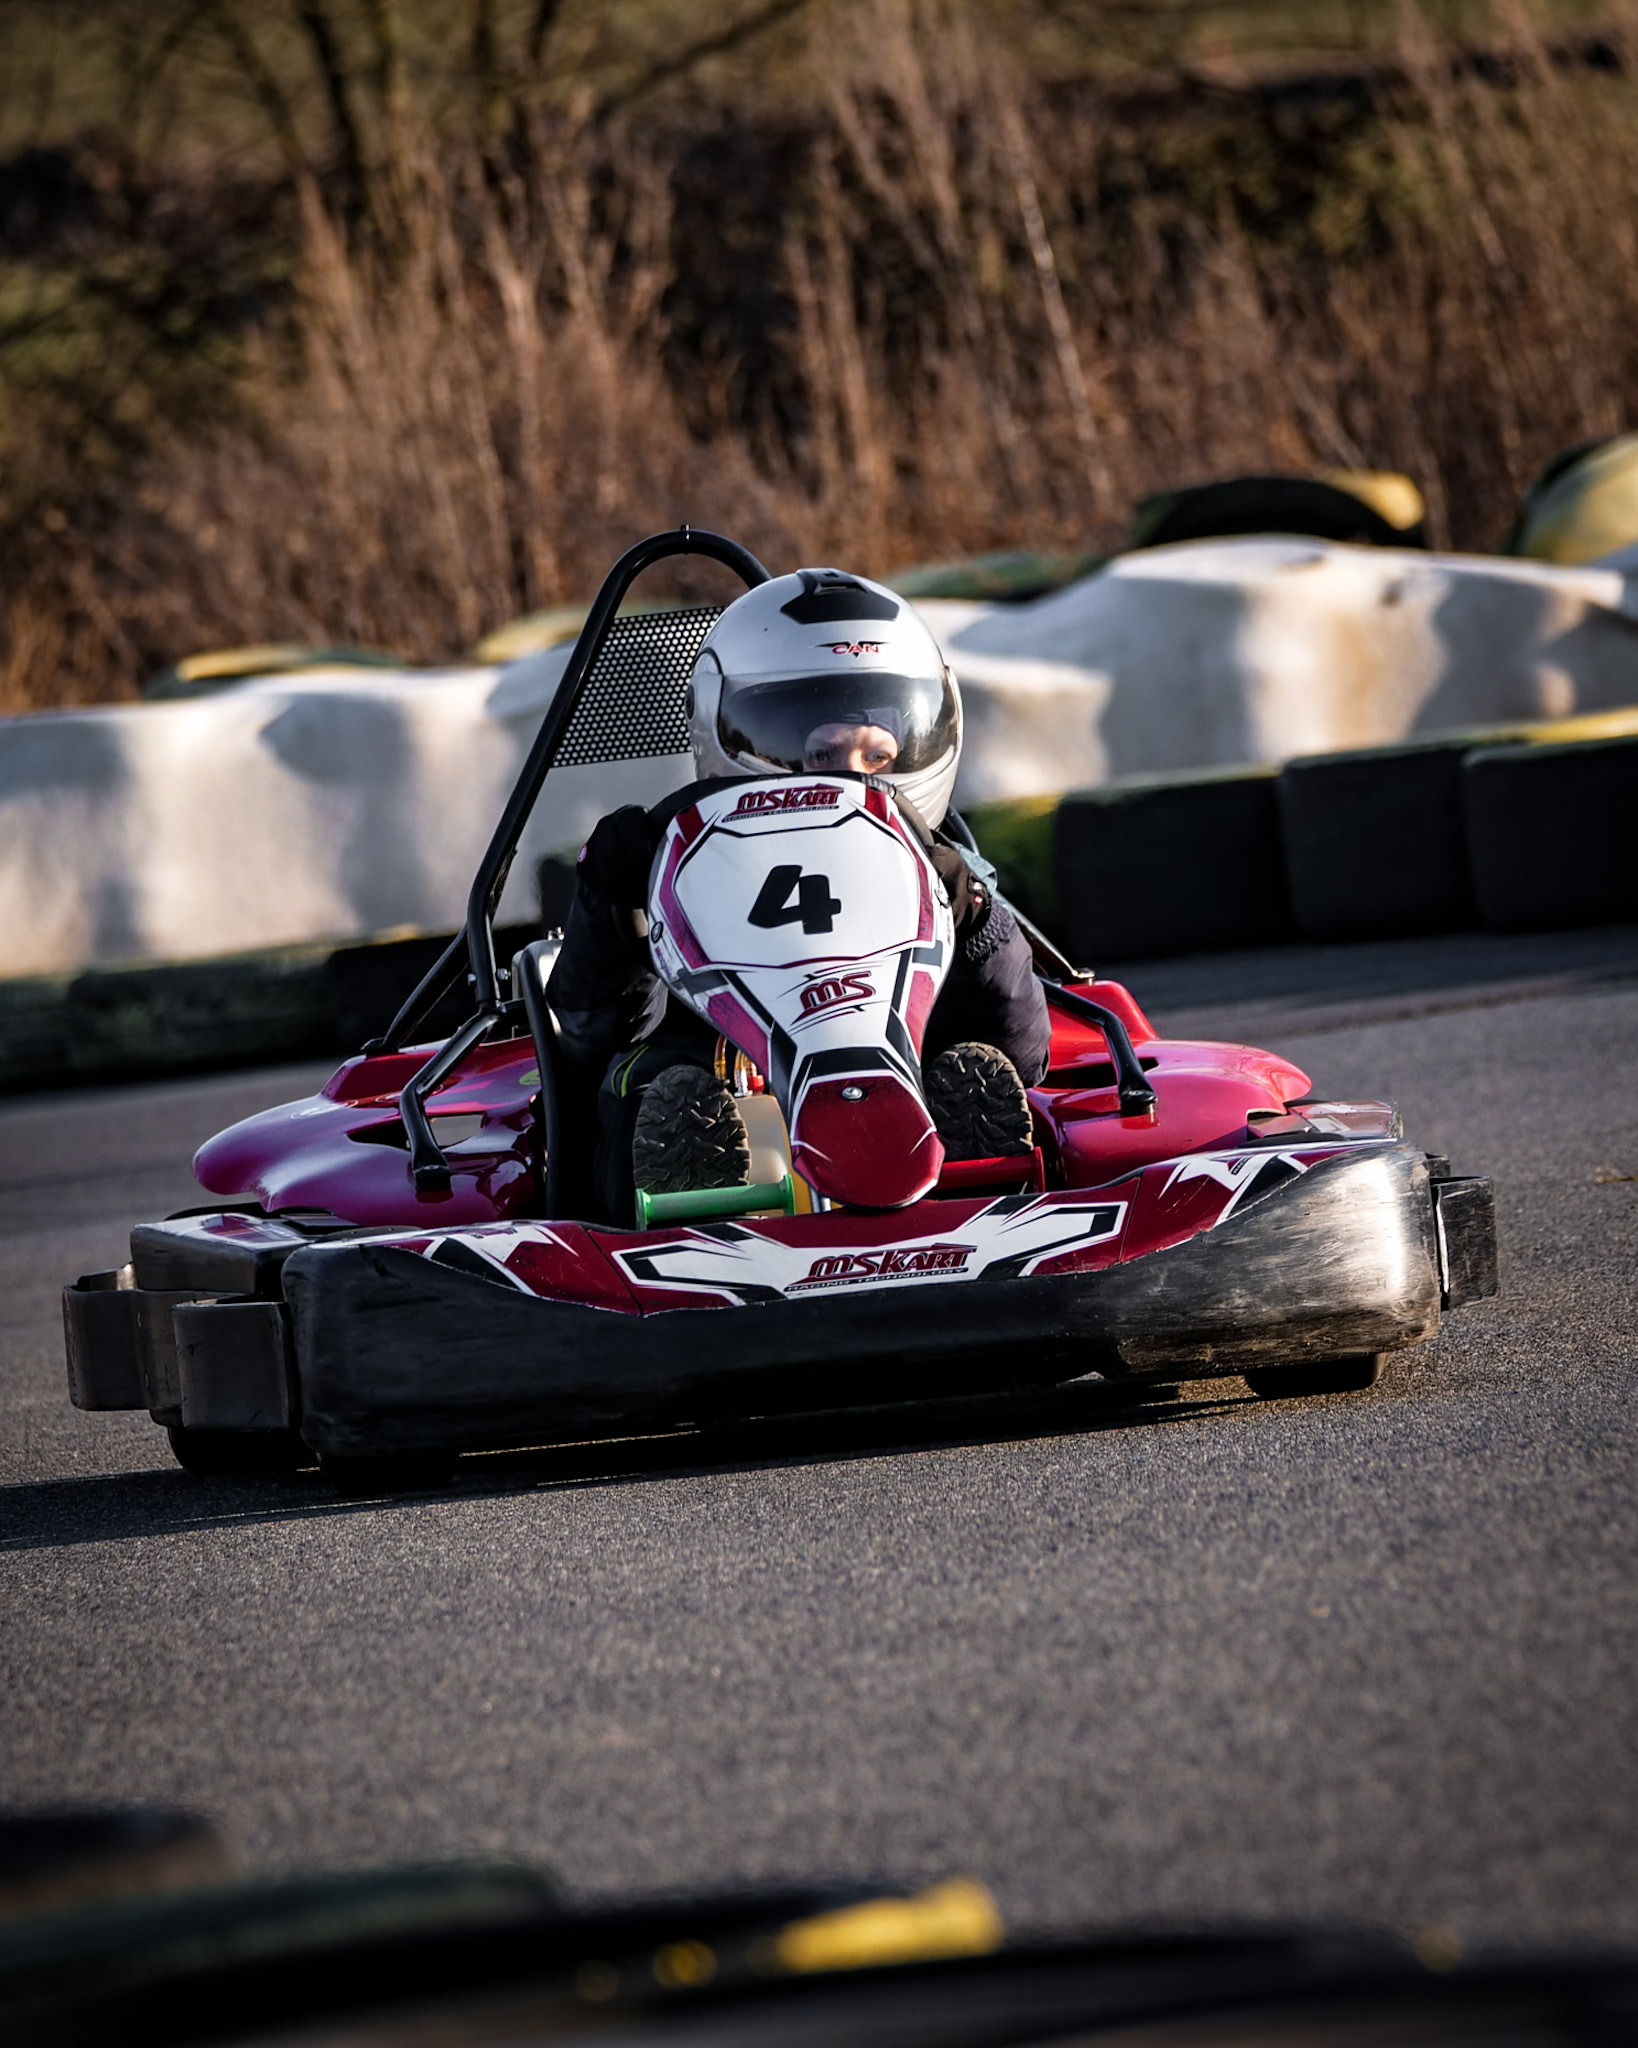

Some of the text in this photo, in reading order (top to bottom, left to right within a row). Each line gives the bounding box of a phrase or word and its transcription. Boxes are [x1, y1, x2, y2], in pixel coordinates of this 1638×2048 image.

[747, 865, 841, 935] 4
[793, 971, 876, 1022] MS
[789, 1243, 977, 1286] MSKART
